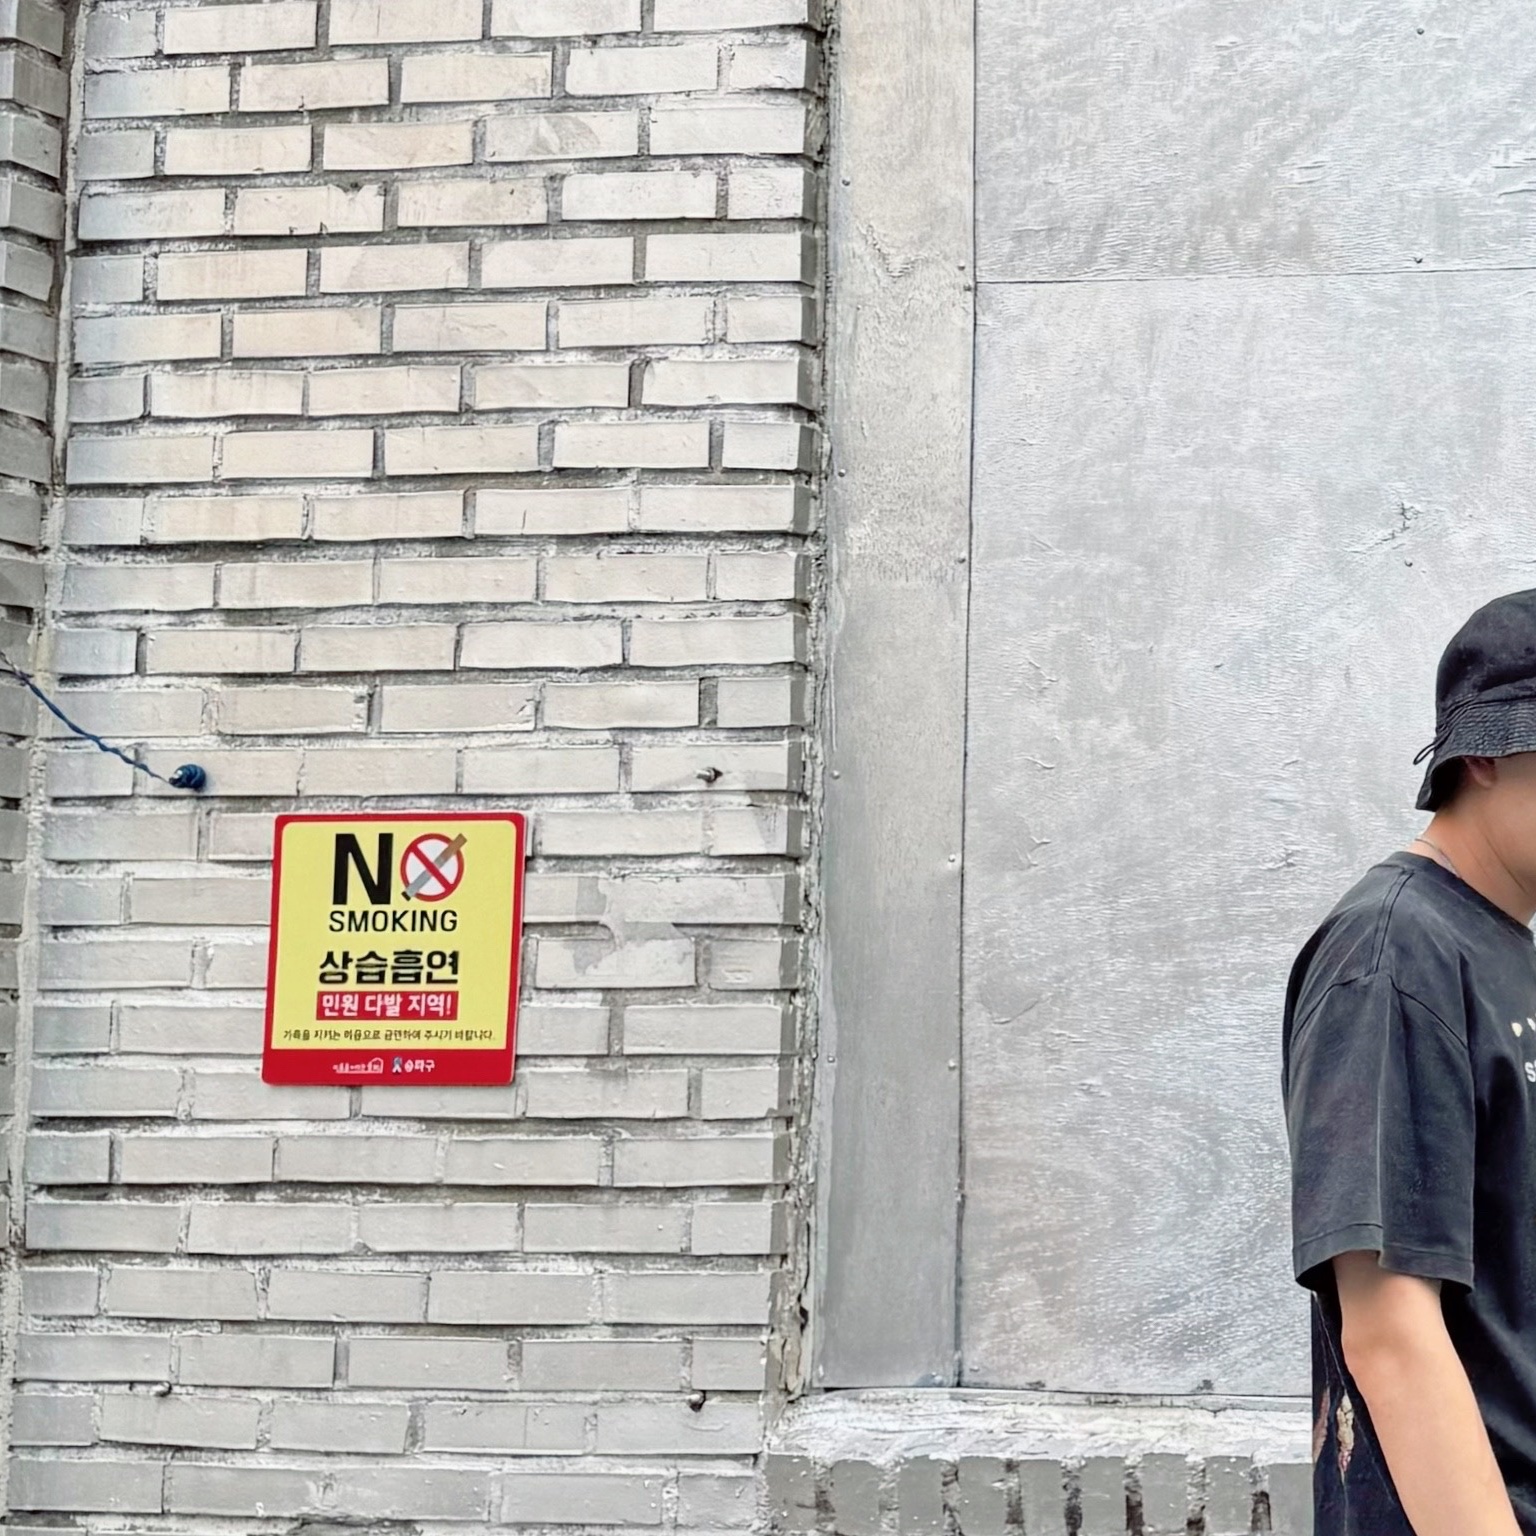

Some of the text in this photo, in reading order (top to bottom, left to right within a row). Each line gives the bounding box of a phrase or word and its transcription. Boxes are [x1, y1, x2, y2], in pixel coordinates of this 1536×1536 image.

[329, 909, 458, 933] SMOKING
[318, 948, 460, 985] 상습흡연
[322, 993, 452, 1018] 민원 다발 지역!
